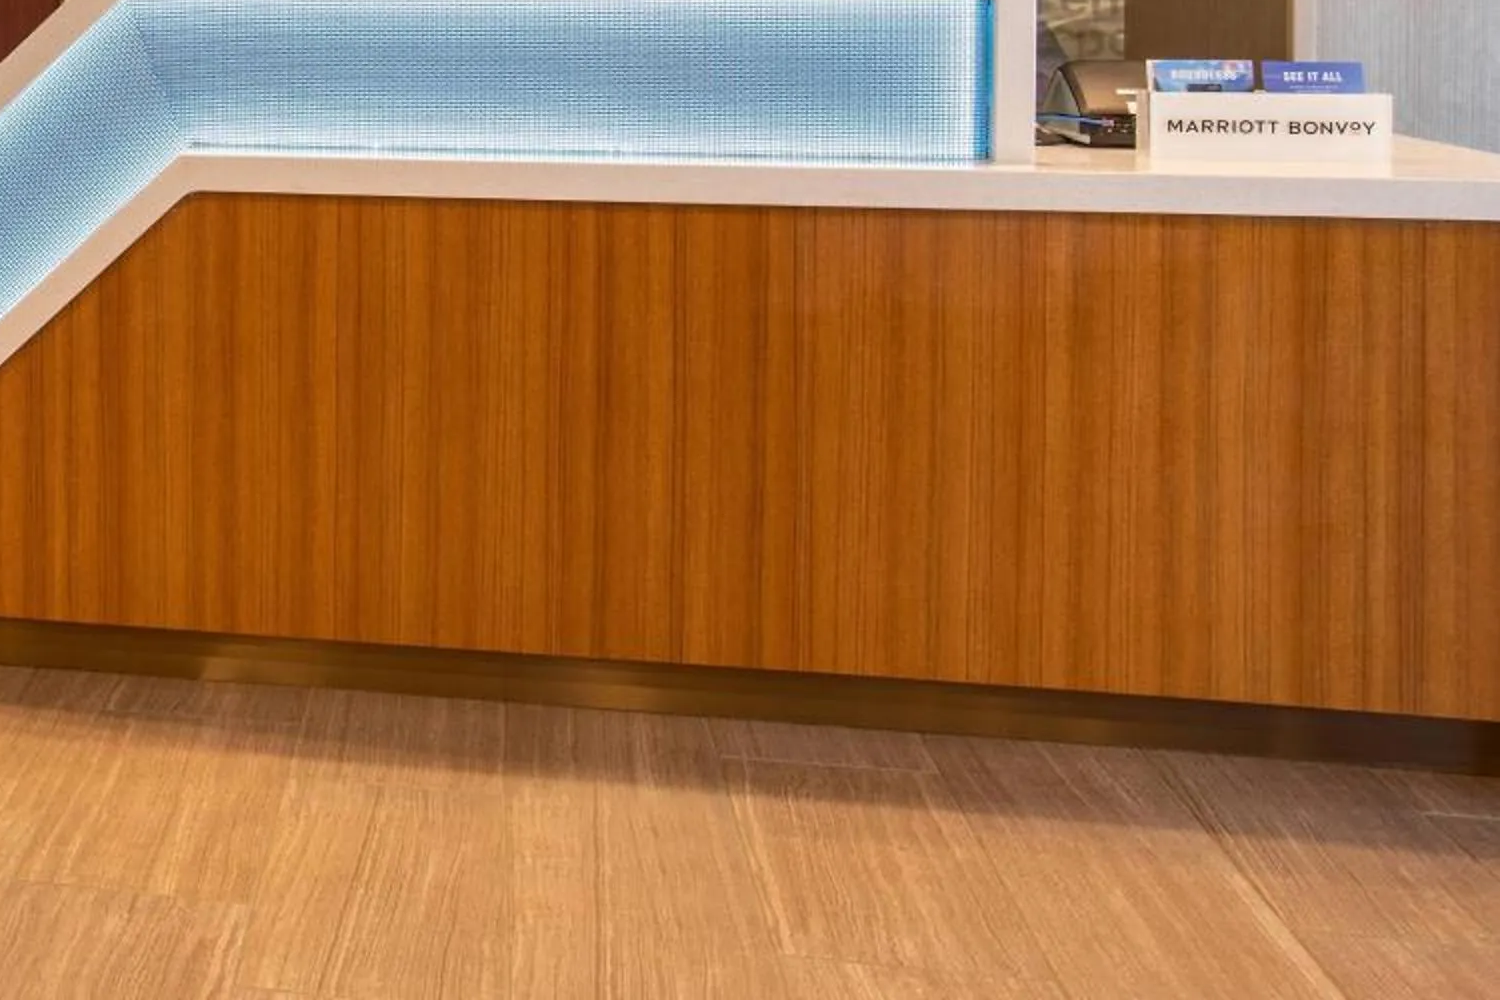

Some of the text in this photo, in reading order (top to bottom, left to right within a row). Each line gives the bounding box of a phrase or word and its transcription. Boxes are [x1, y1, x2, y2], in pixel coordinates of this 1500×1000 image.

[1283, 71, 1343, 82] SEE IT ALL
[1167, 119, 1376, 135] MARRIOTT BONVOY
